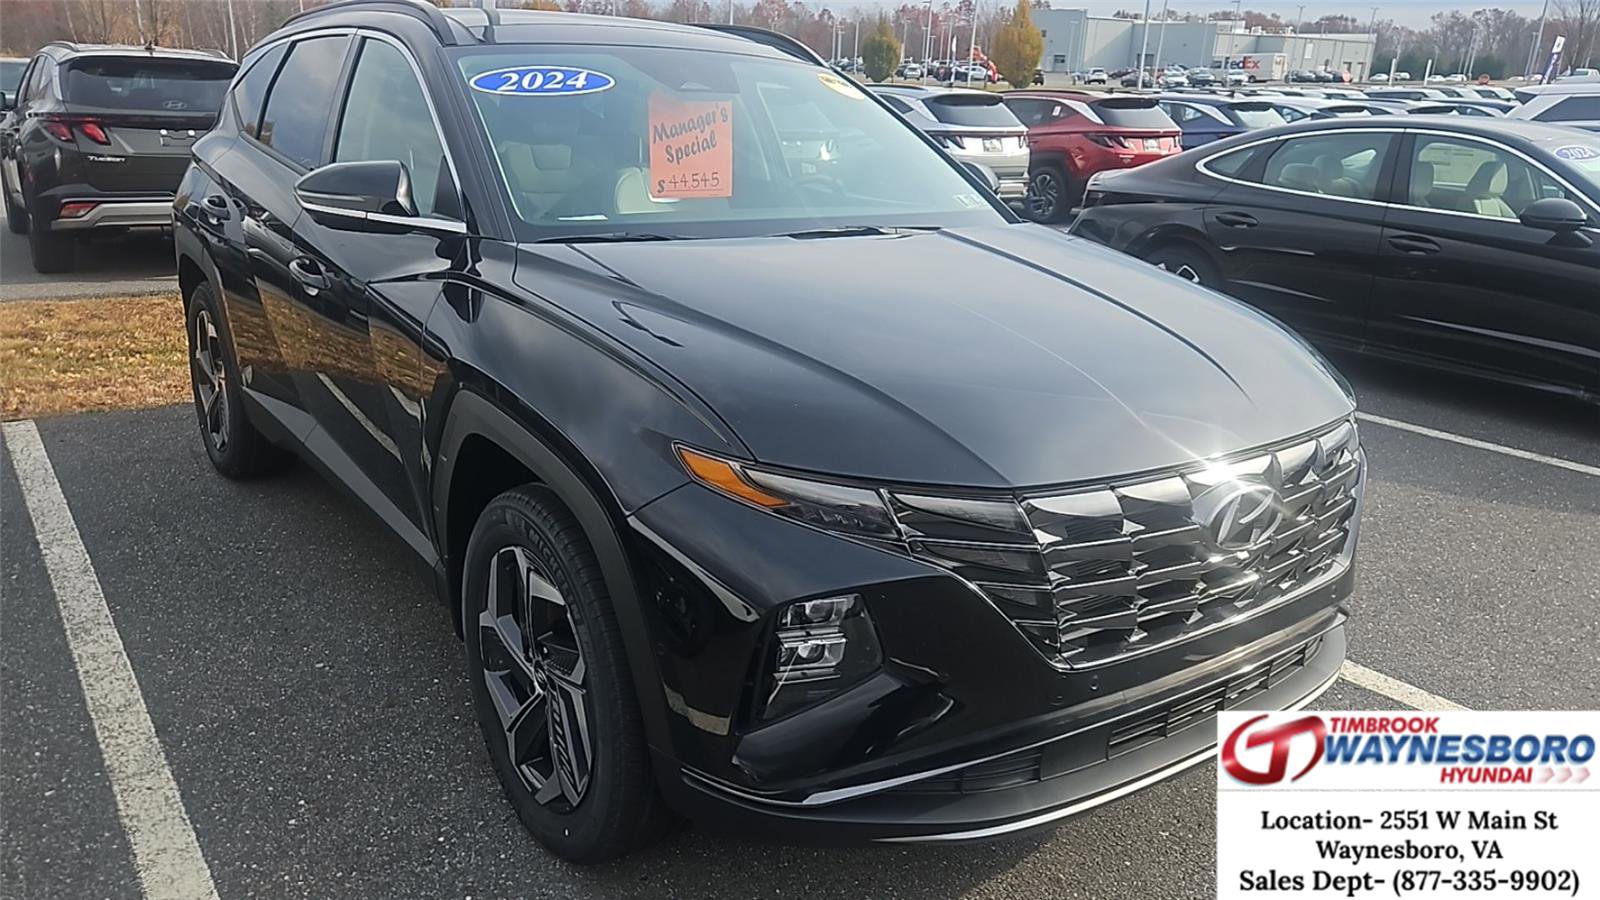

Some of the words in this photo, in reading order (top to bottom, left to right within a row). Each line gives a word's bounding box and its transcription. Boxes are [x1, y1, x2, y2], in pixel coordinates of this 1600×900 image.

[497, 71, 589, 91] 2024
[653, 102, 729, 144] Manager's
[665, 130, 717, 165] Special
[529, 529, 582, 621] MICHELIN
